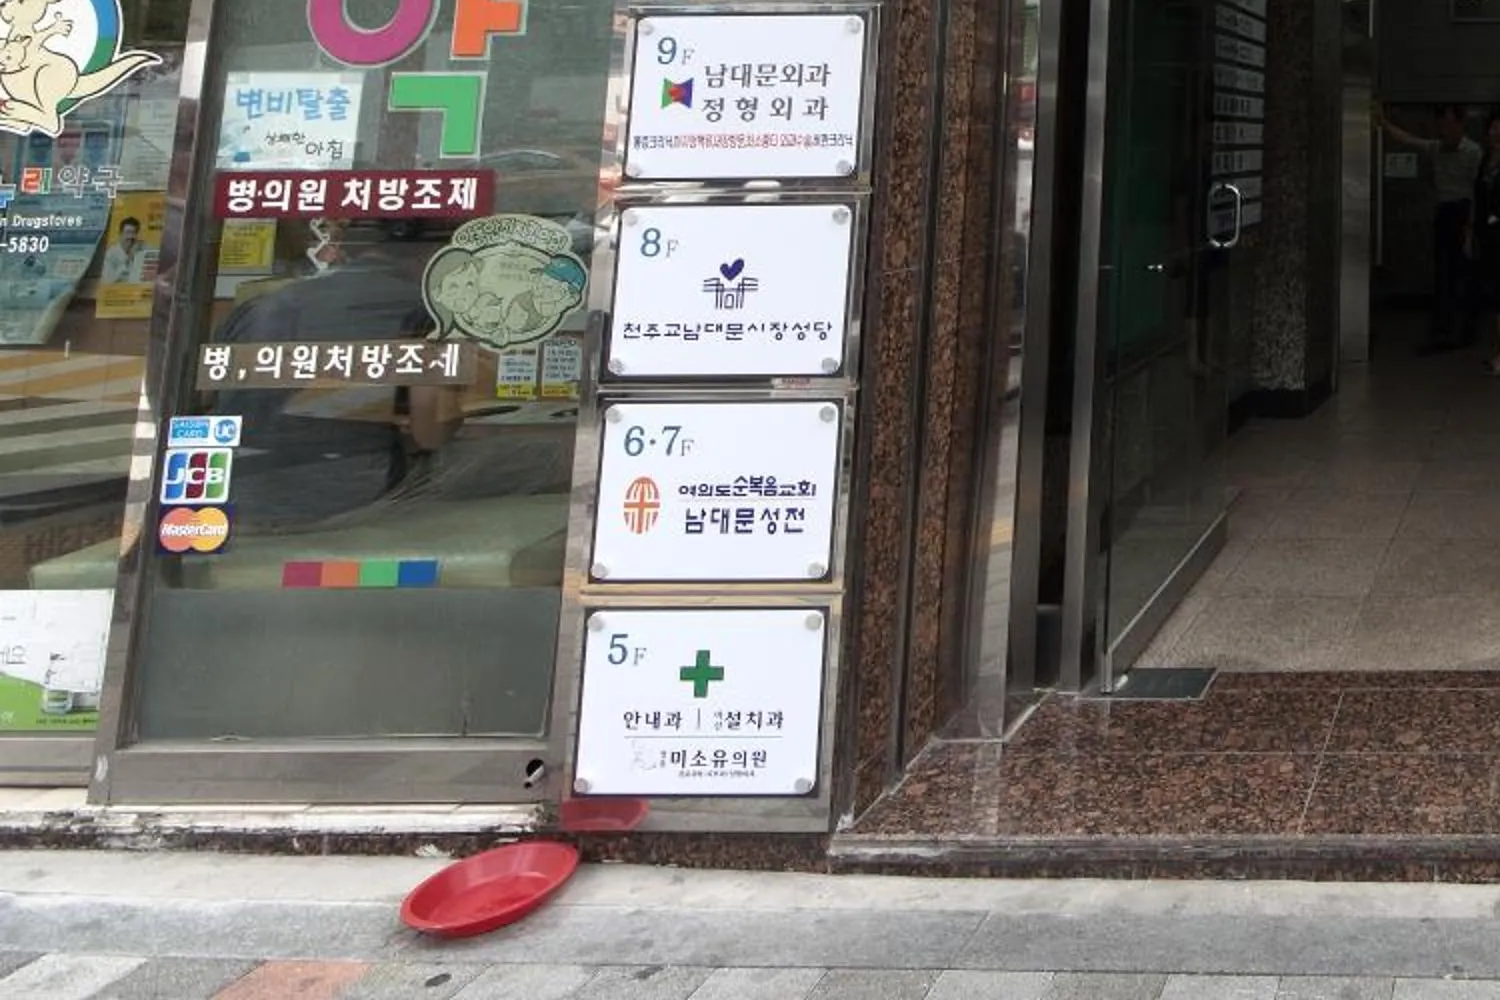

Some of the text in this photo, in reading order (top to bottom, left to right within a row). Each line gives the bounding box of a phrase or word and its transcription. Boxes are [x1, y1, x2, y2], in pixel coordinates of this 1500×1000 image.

[656, 36, 695, 65] 9F
[704, 63, 832, 89] 남대문외과
[236, 87, 351, 121] 변비탈출
[57, 164, 123, 199] 약국
[341, 177, 478, 211] 처방조제
[640, 228, 678, 257] 8F
[623, 322, 833, 341] 천주교남대문시장성당
[165, 466, 226, 486] JCB
[678, 475, 817, 497] 여의도순복음교회
[684, 507, 806, 535] 남대문성전
[607, 633, 647, 666] 5F
